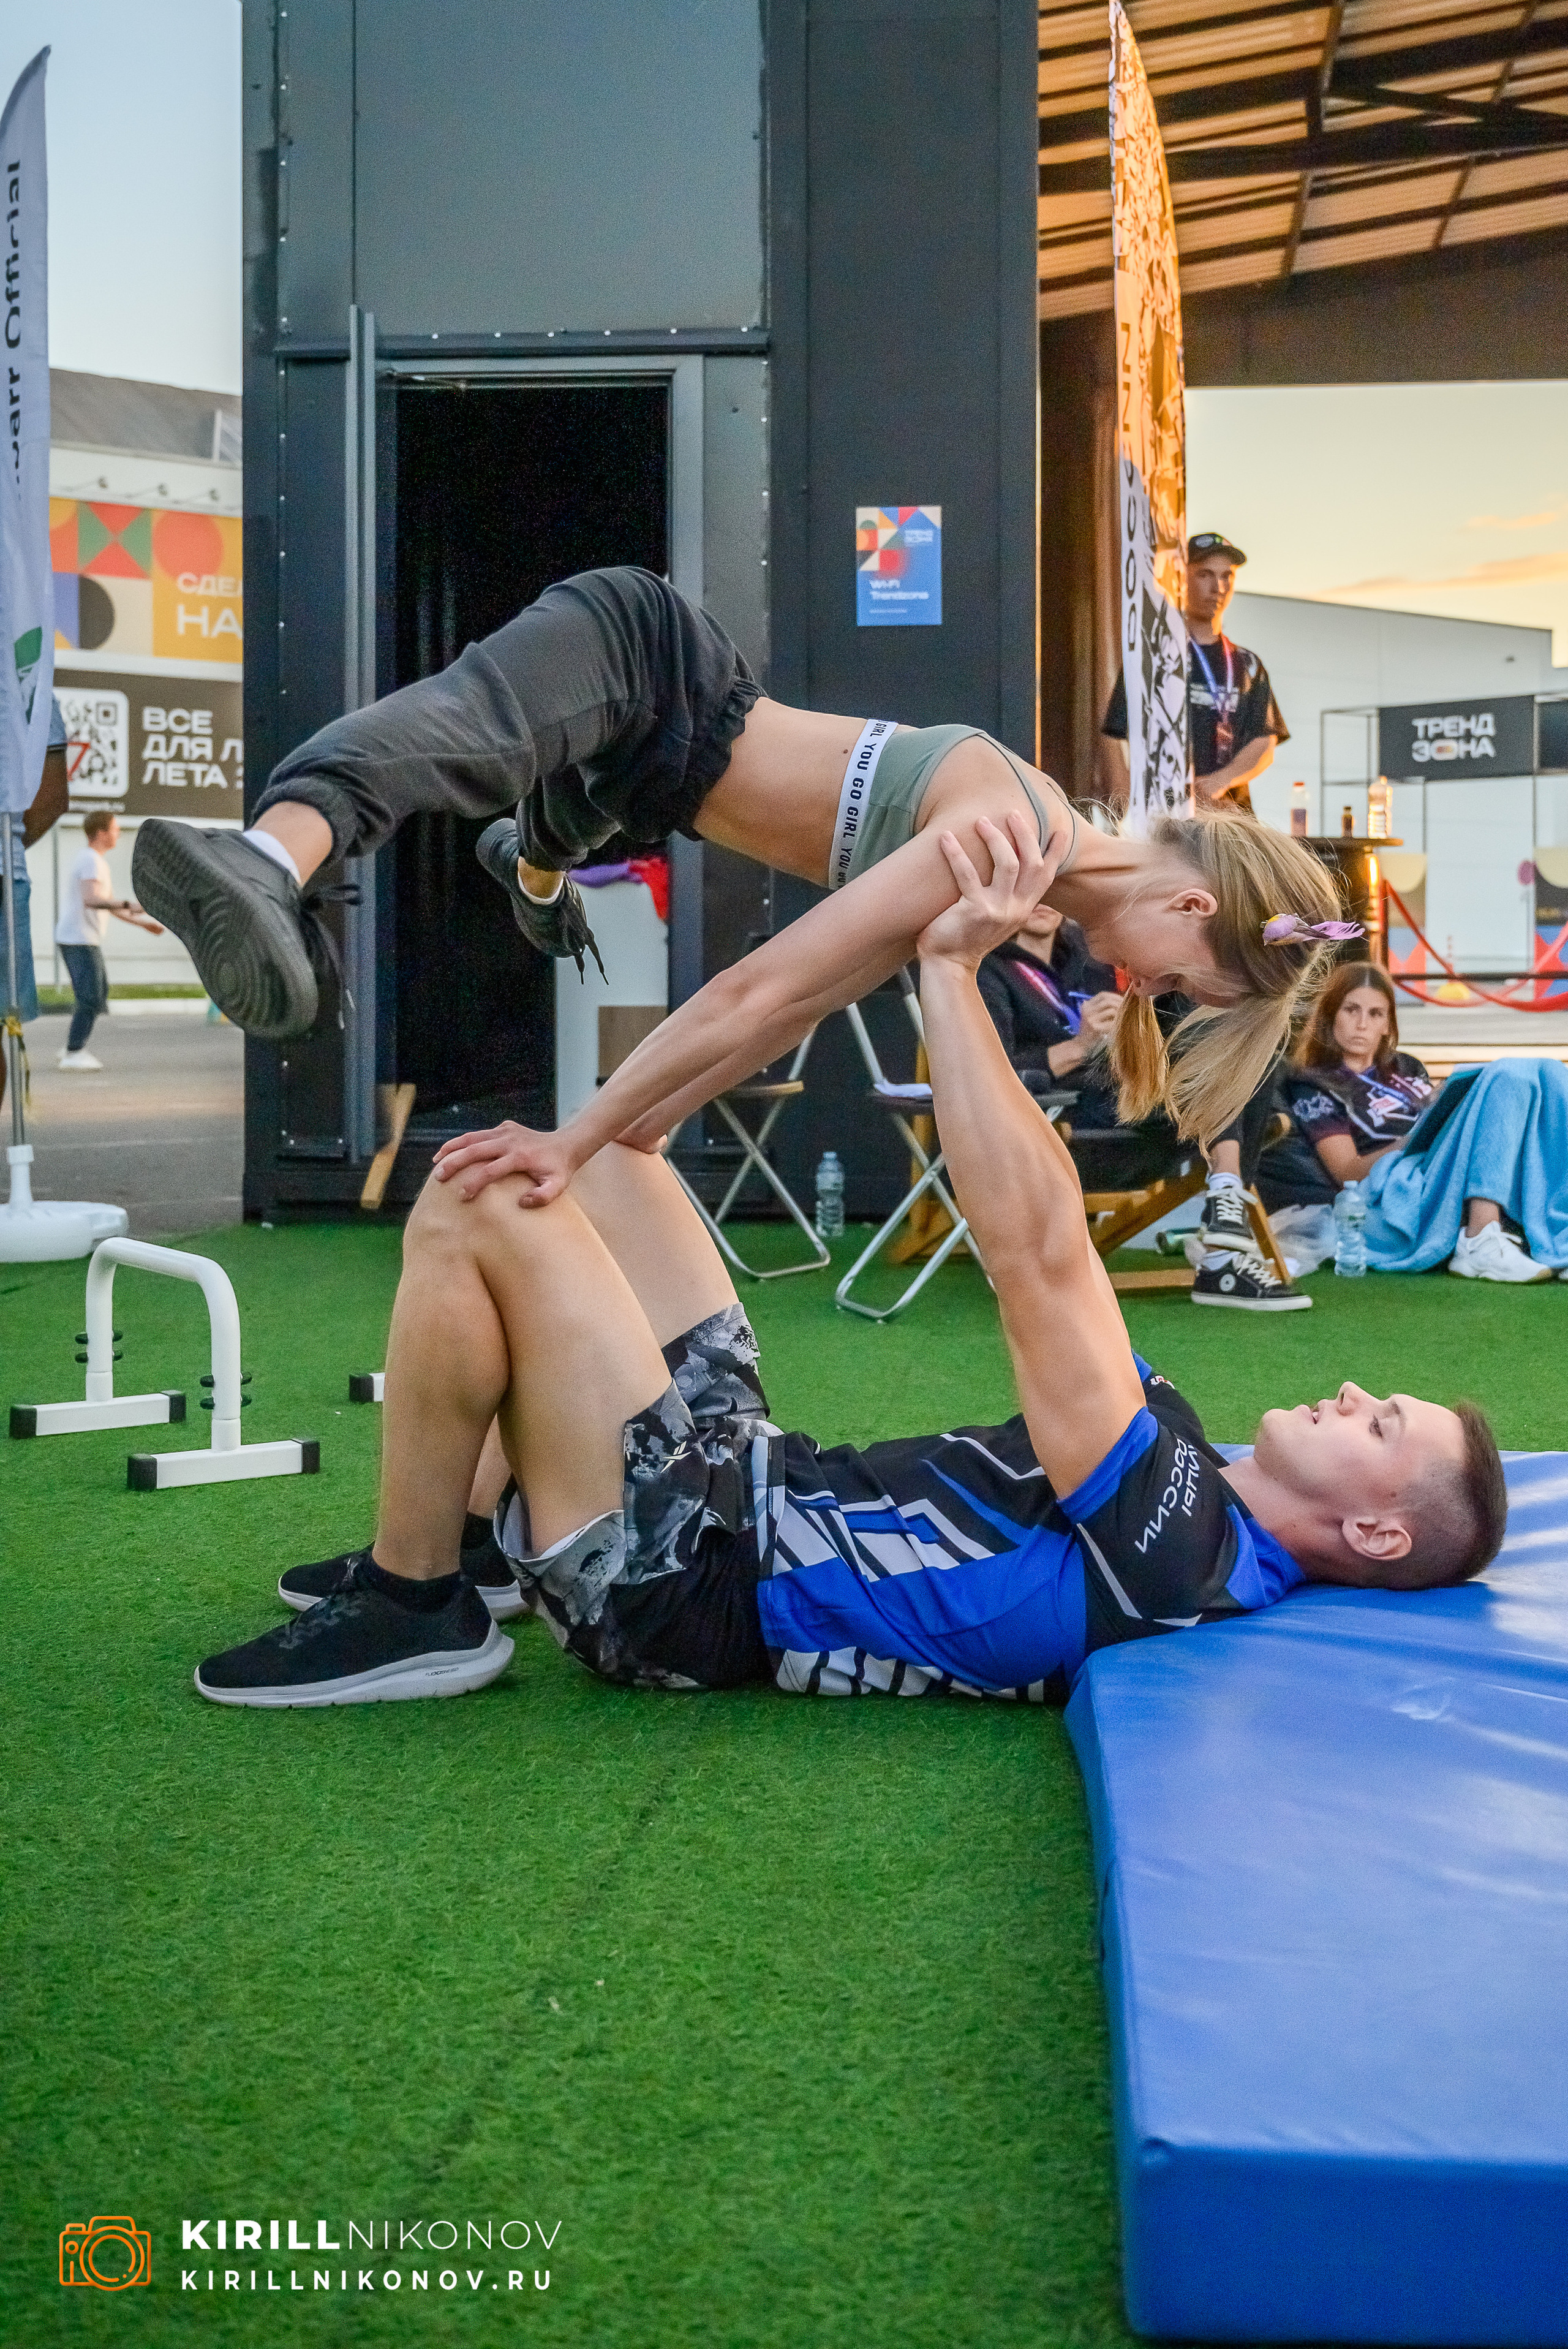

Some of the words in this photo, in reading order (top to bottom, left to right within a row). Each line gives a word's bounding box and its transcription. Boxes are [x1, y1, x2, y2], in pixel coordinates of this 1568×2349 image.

[177, 572, 243, 597] СДЕ
[143, 706, 213, 735] ВСЕ
[870, 723, 887, 736] GIRL
[1411, 713, 1495, 739] ТРЕНД
[141, 735, 213, 762] ДЛЯ
[857, 743, 876, 770] YOU
[1411, 736, 1495, 763] ЗОНА
[143, 761, 228, 789] ЛЕТА
[850, 777, 864, 800] GO
[842, 806, 859, 839] GIRL
[839, 847, 852, 869] YOU
